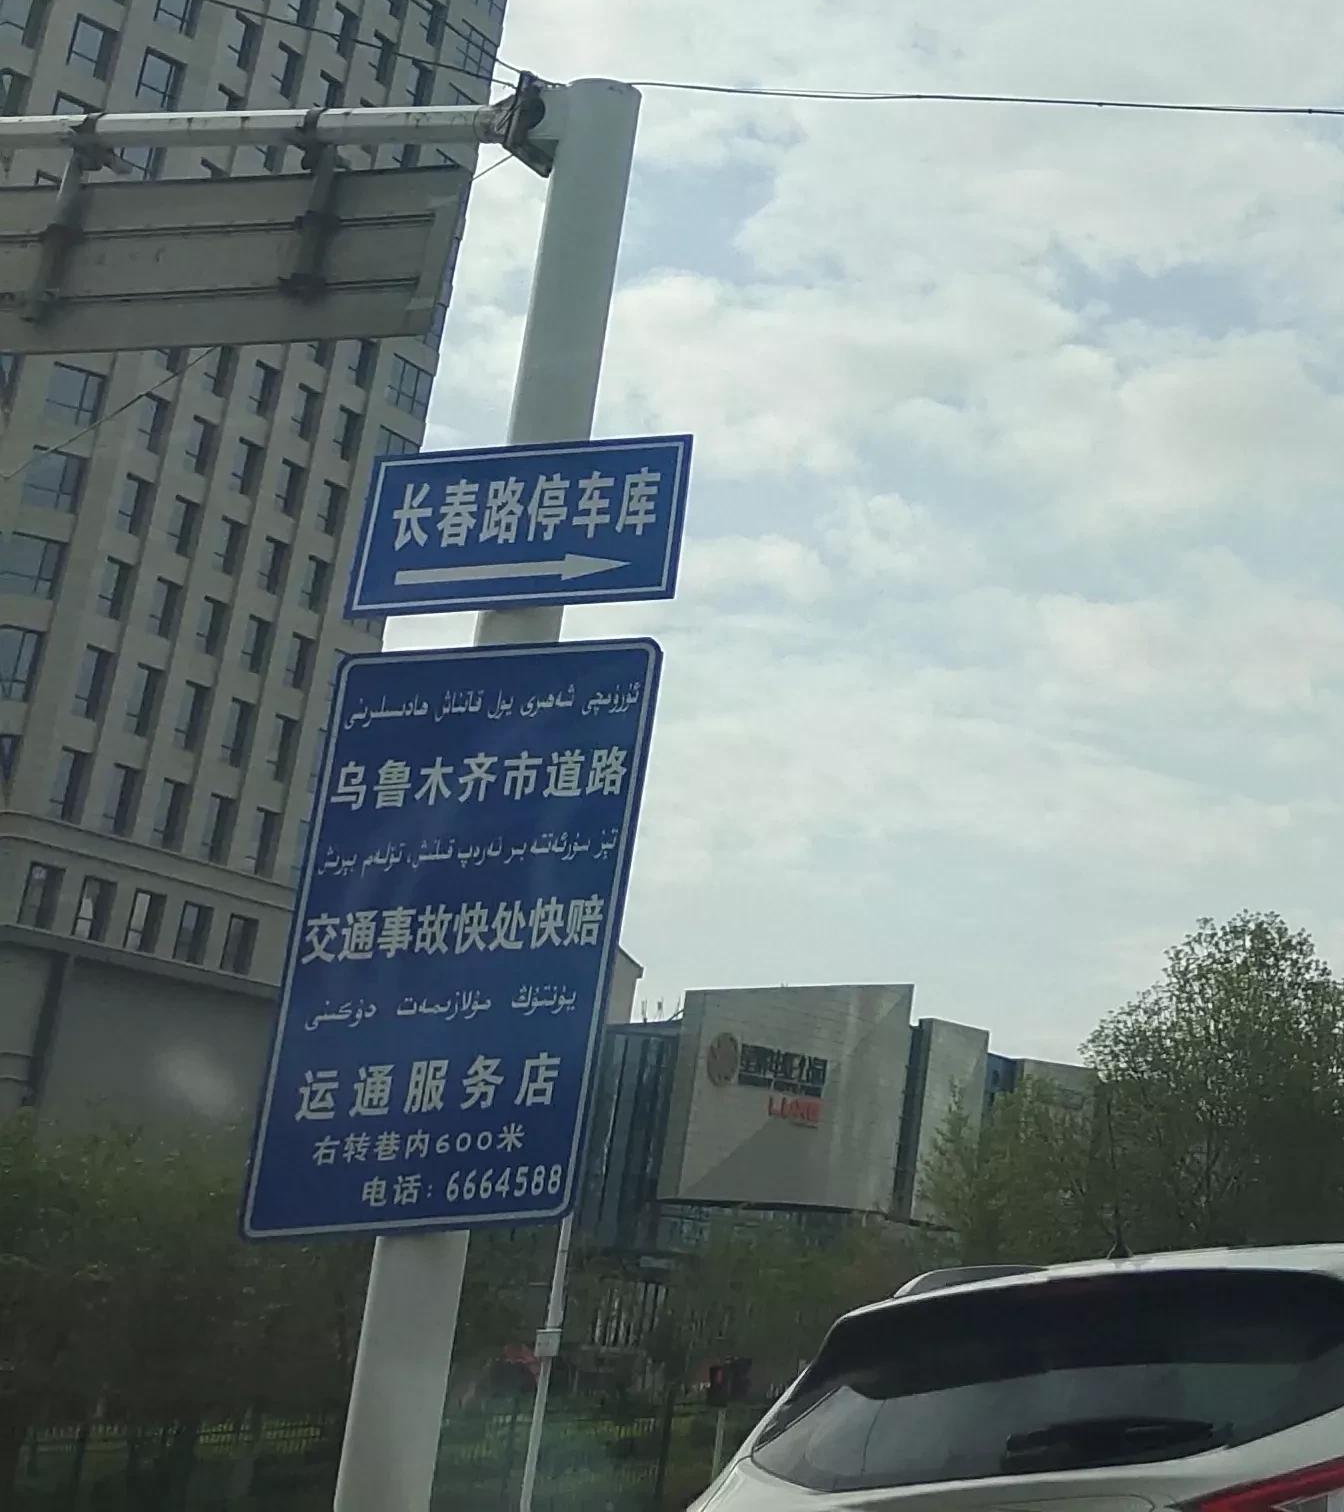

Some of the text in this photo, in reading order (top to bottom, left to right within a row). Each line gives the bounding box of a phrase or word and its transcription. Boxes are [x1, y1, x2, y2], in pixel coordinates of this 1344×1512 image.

[392, 466, 661, 551] 长春路停车库
[330, 745, 629, 811] 乌鲁木齐市道路
[301, 892, 605, 965] 交通事故快处快赔
[294, 1051, 561, 1121] 运通服务店
[312, 1122, 525, 1167] 右转巷内600米
[361, 1163, 563, 1208] 电话：6664588
